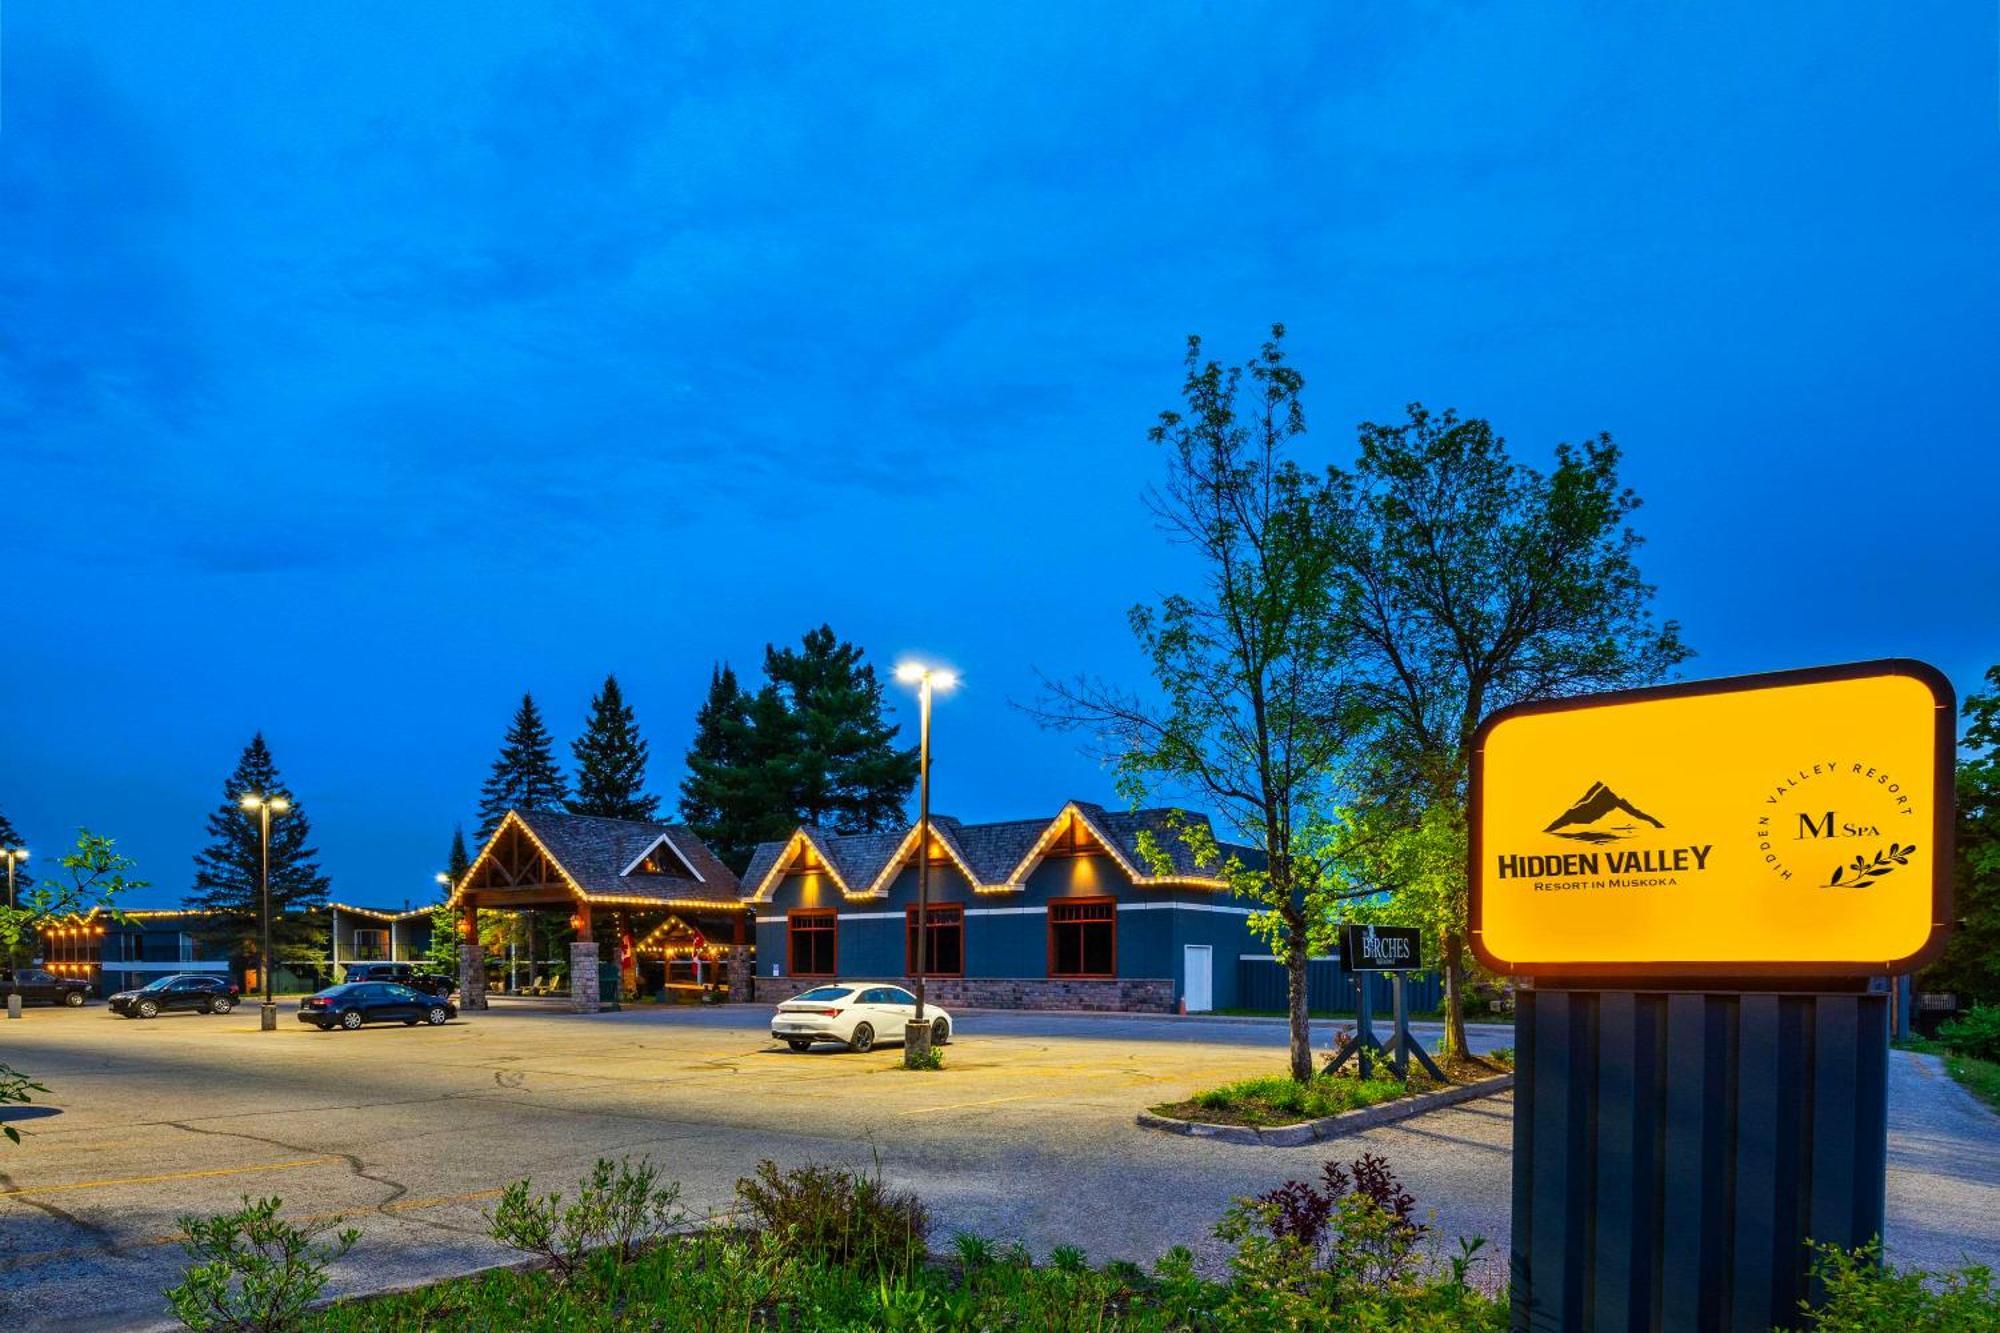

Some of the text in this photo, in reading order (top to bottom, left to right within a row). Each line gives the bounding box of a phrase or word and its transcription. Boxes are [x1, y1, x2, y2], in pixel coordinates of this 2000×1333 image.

[1758, 762, 1913, 880] HIDDEN VALLEY RESORT
[1793, 811, 1839, 841] M
[1498, 844, 1713, 880] HIDDEN VALLEY
[1534, 877, 1677, 891] RESORT IN MUSKOKA
